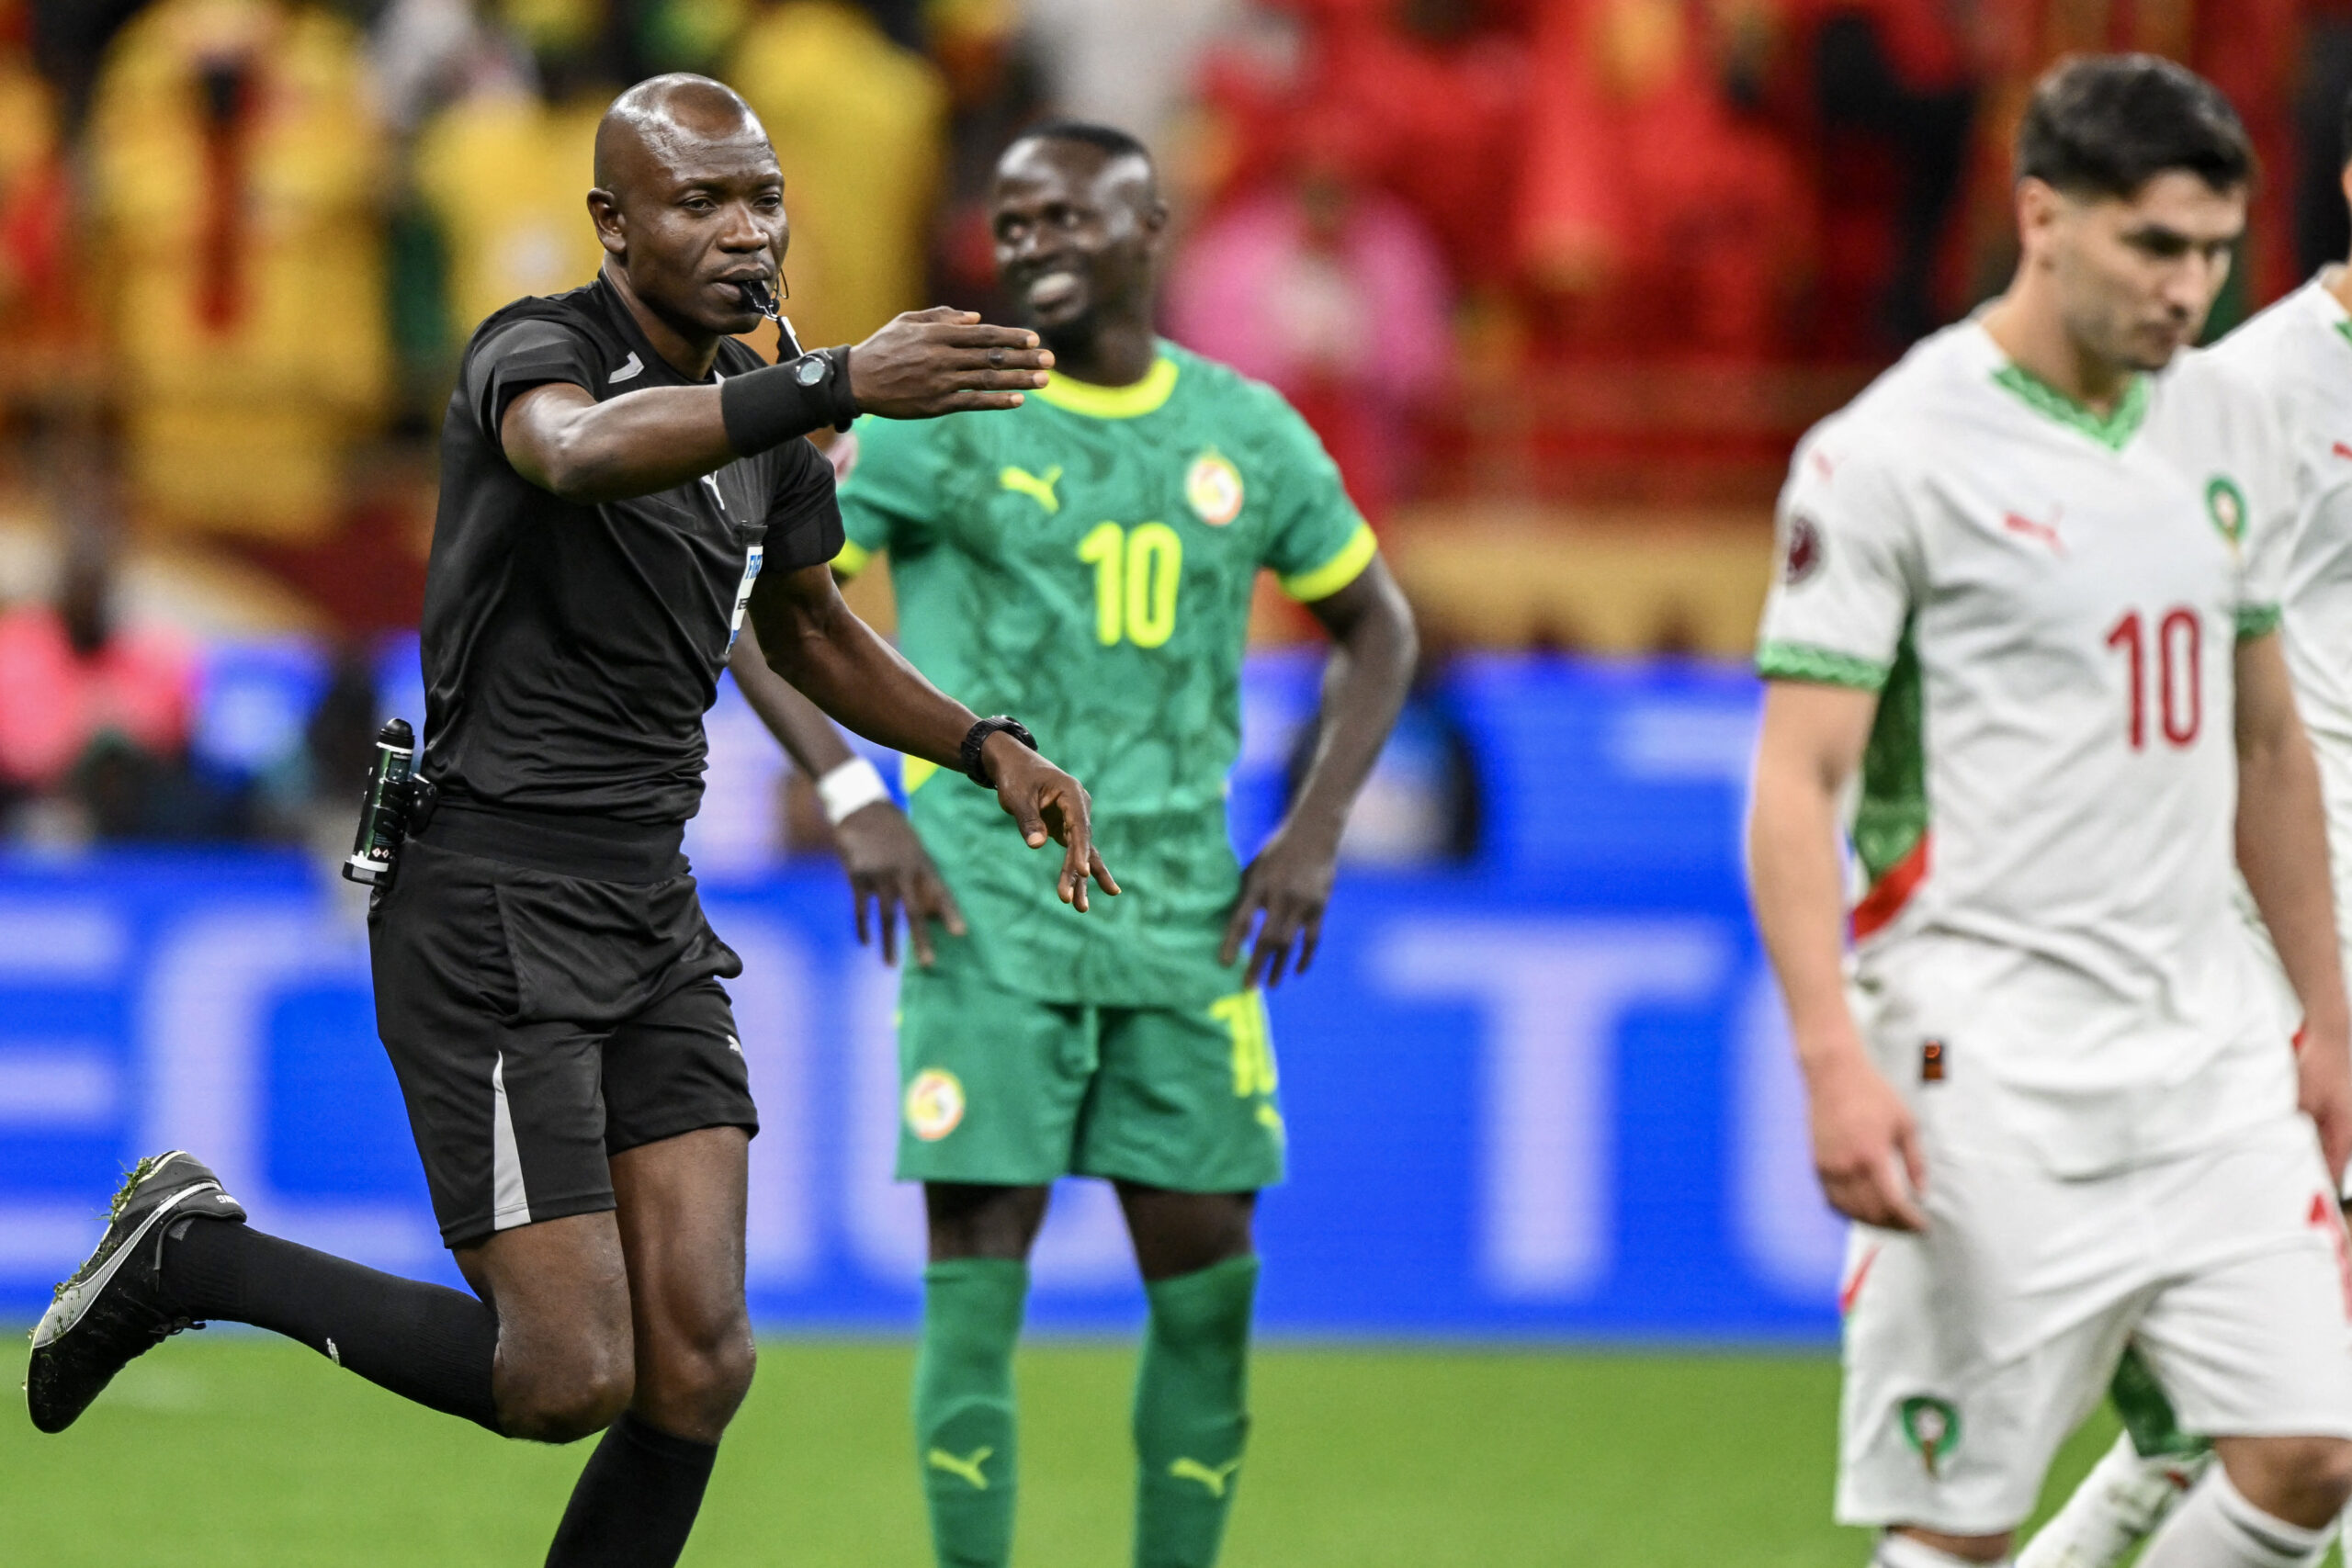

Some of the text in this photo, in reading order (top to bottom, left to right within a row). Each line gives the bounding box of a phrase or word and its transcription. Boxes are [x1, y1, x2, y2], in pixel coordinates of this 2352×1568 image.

[745, 555, 763, 580] FIF
[1077, 521, 1182, 649] 10
[2107, 605, 2203, 751] 10
